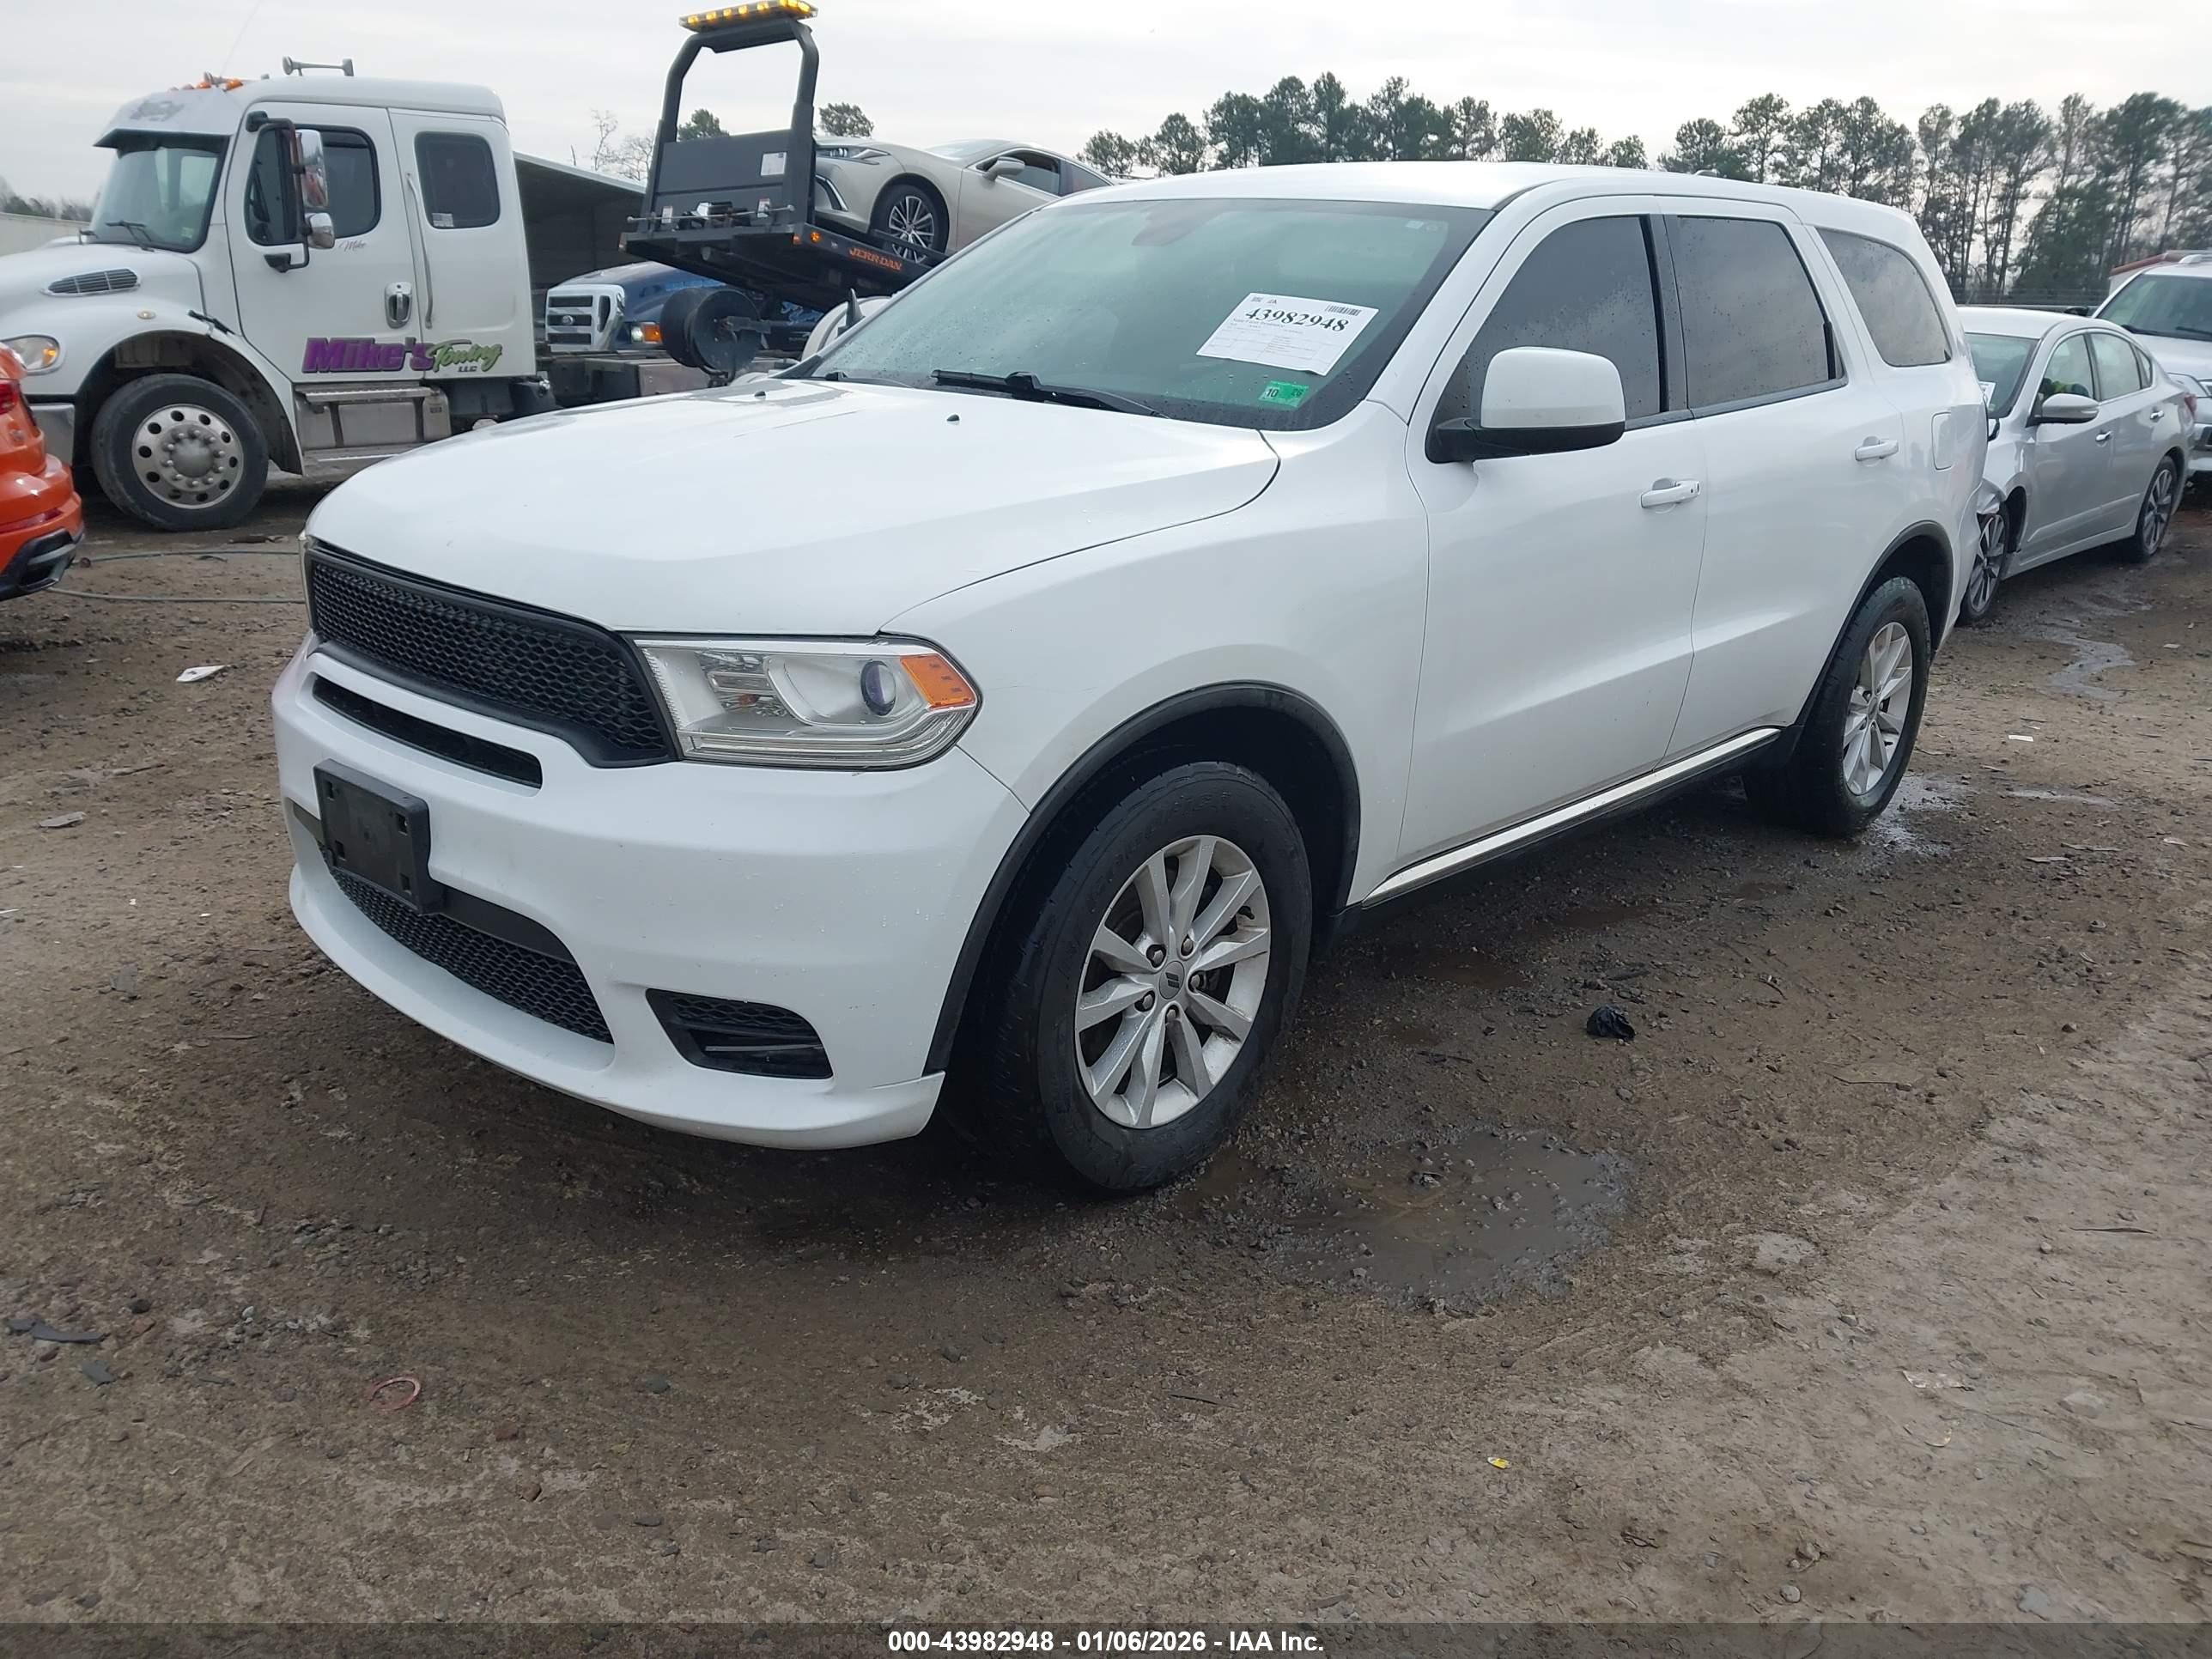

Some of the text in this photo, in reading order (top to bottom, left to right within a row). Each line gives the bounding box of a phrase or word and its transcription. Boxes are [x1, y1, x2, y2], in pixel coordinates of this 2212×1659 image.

[1245, 307, 1349, 331] 43982948
[302, 337, 502, 373] Mike's Towing
